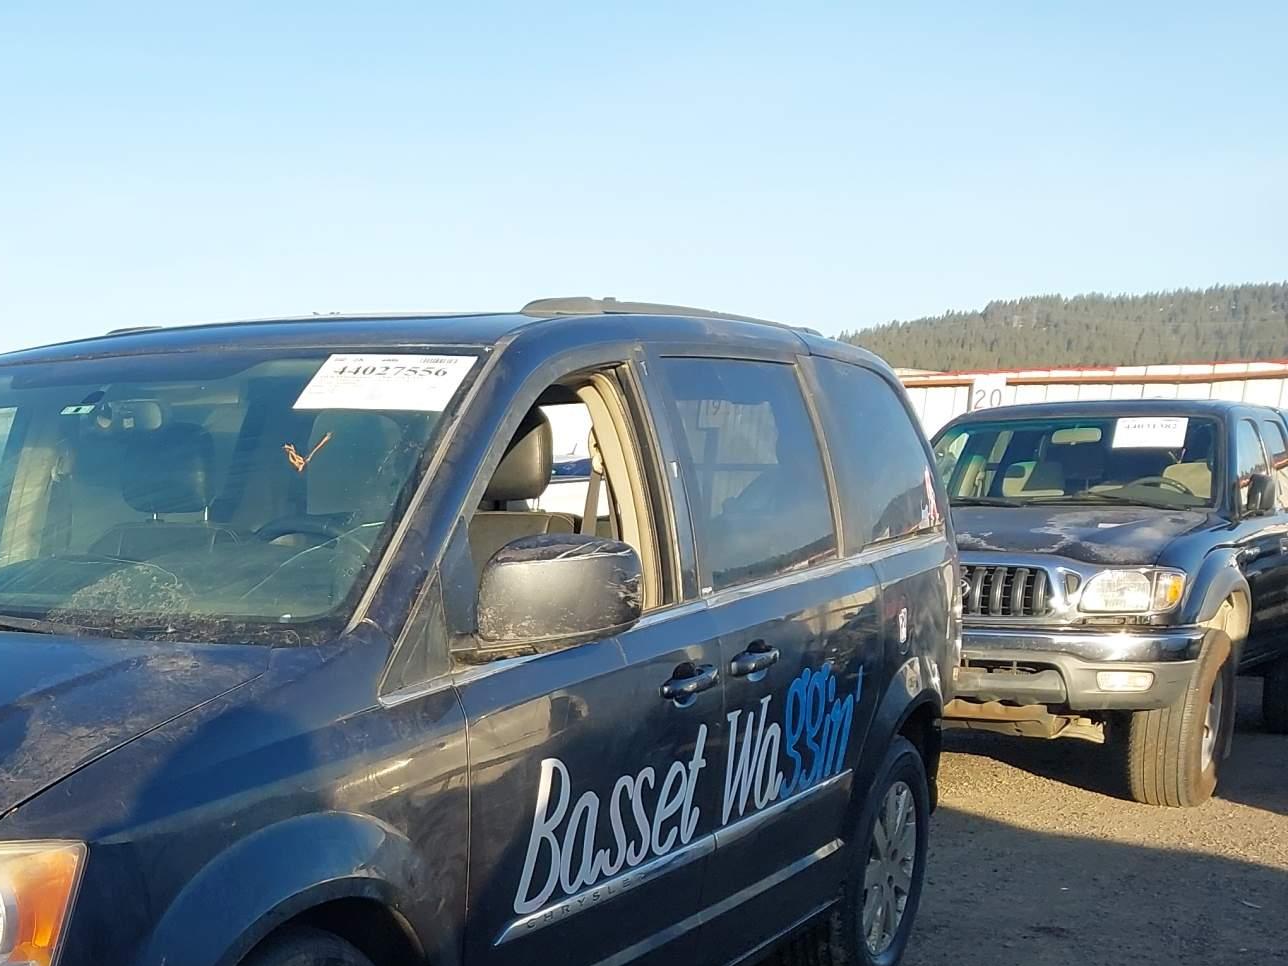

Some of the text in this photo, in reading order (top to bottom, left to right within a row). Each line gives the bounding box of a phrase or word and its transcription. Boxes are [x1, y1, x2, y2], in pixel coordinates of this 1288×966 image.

[333, 365, 449, 378] 44027556
[974, 388, 1002, 410] 20
[514, 723, 707, 914] Basset
